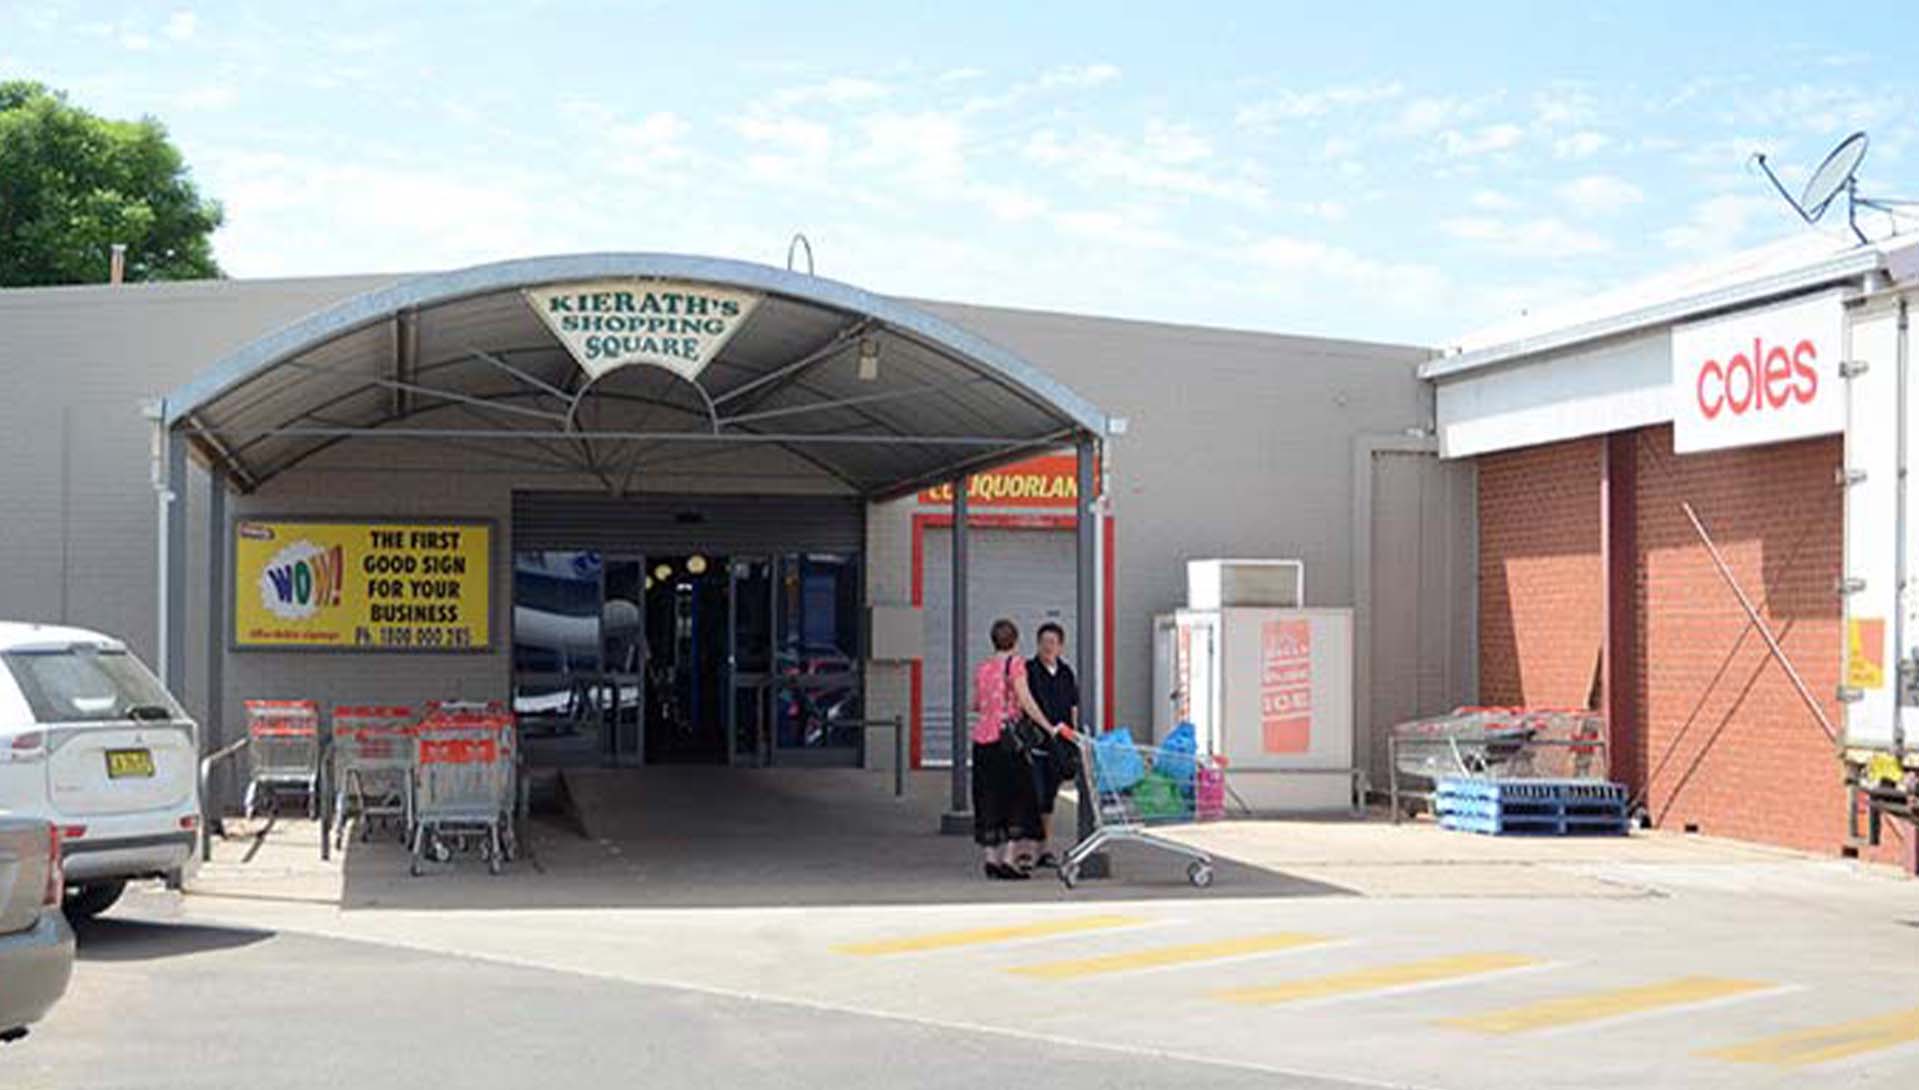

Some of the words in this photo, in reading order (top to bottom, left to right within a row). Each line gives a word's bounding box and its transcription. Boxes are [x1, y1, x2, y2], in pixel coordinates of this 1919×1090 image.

[550, 291, 739, 316] KIERATH'S
[561, 314, 725, 335] SHOPPING
[585, 334, 699, 361] SQUARE
[1697, 337, 1818, 420] coles
[371, 531, 403, 549] THE
[411, 531, 460, 549] FIRST
[363, 555, 417, 574] GOOD
[422, 555, 465, 574] SIGN
[368, 579, 403, 598] FOR
[410, 579, 460, 598] YOUR
[370, 604, 458, 623] BUSINESS
